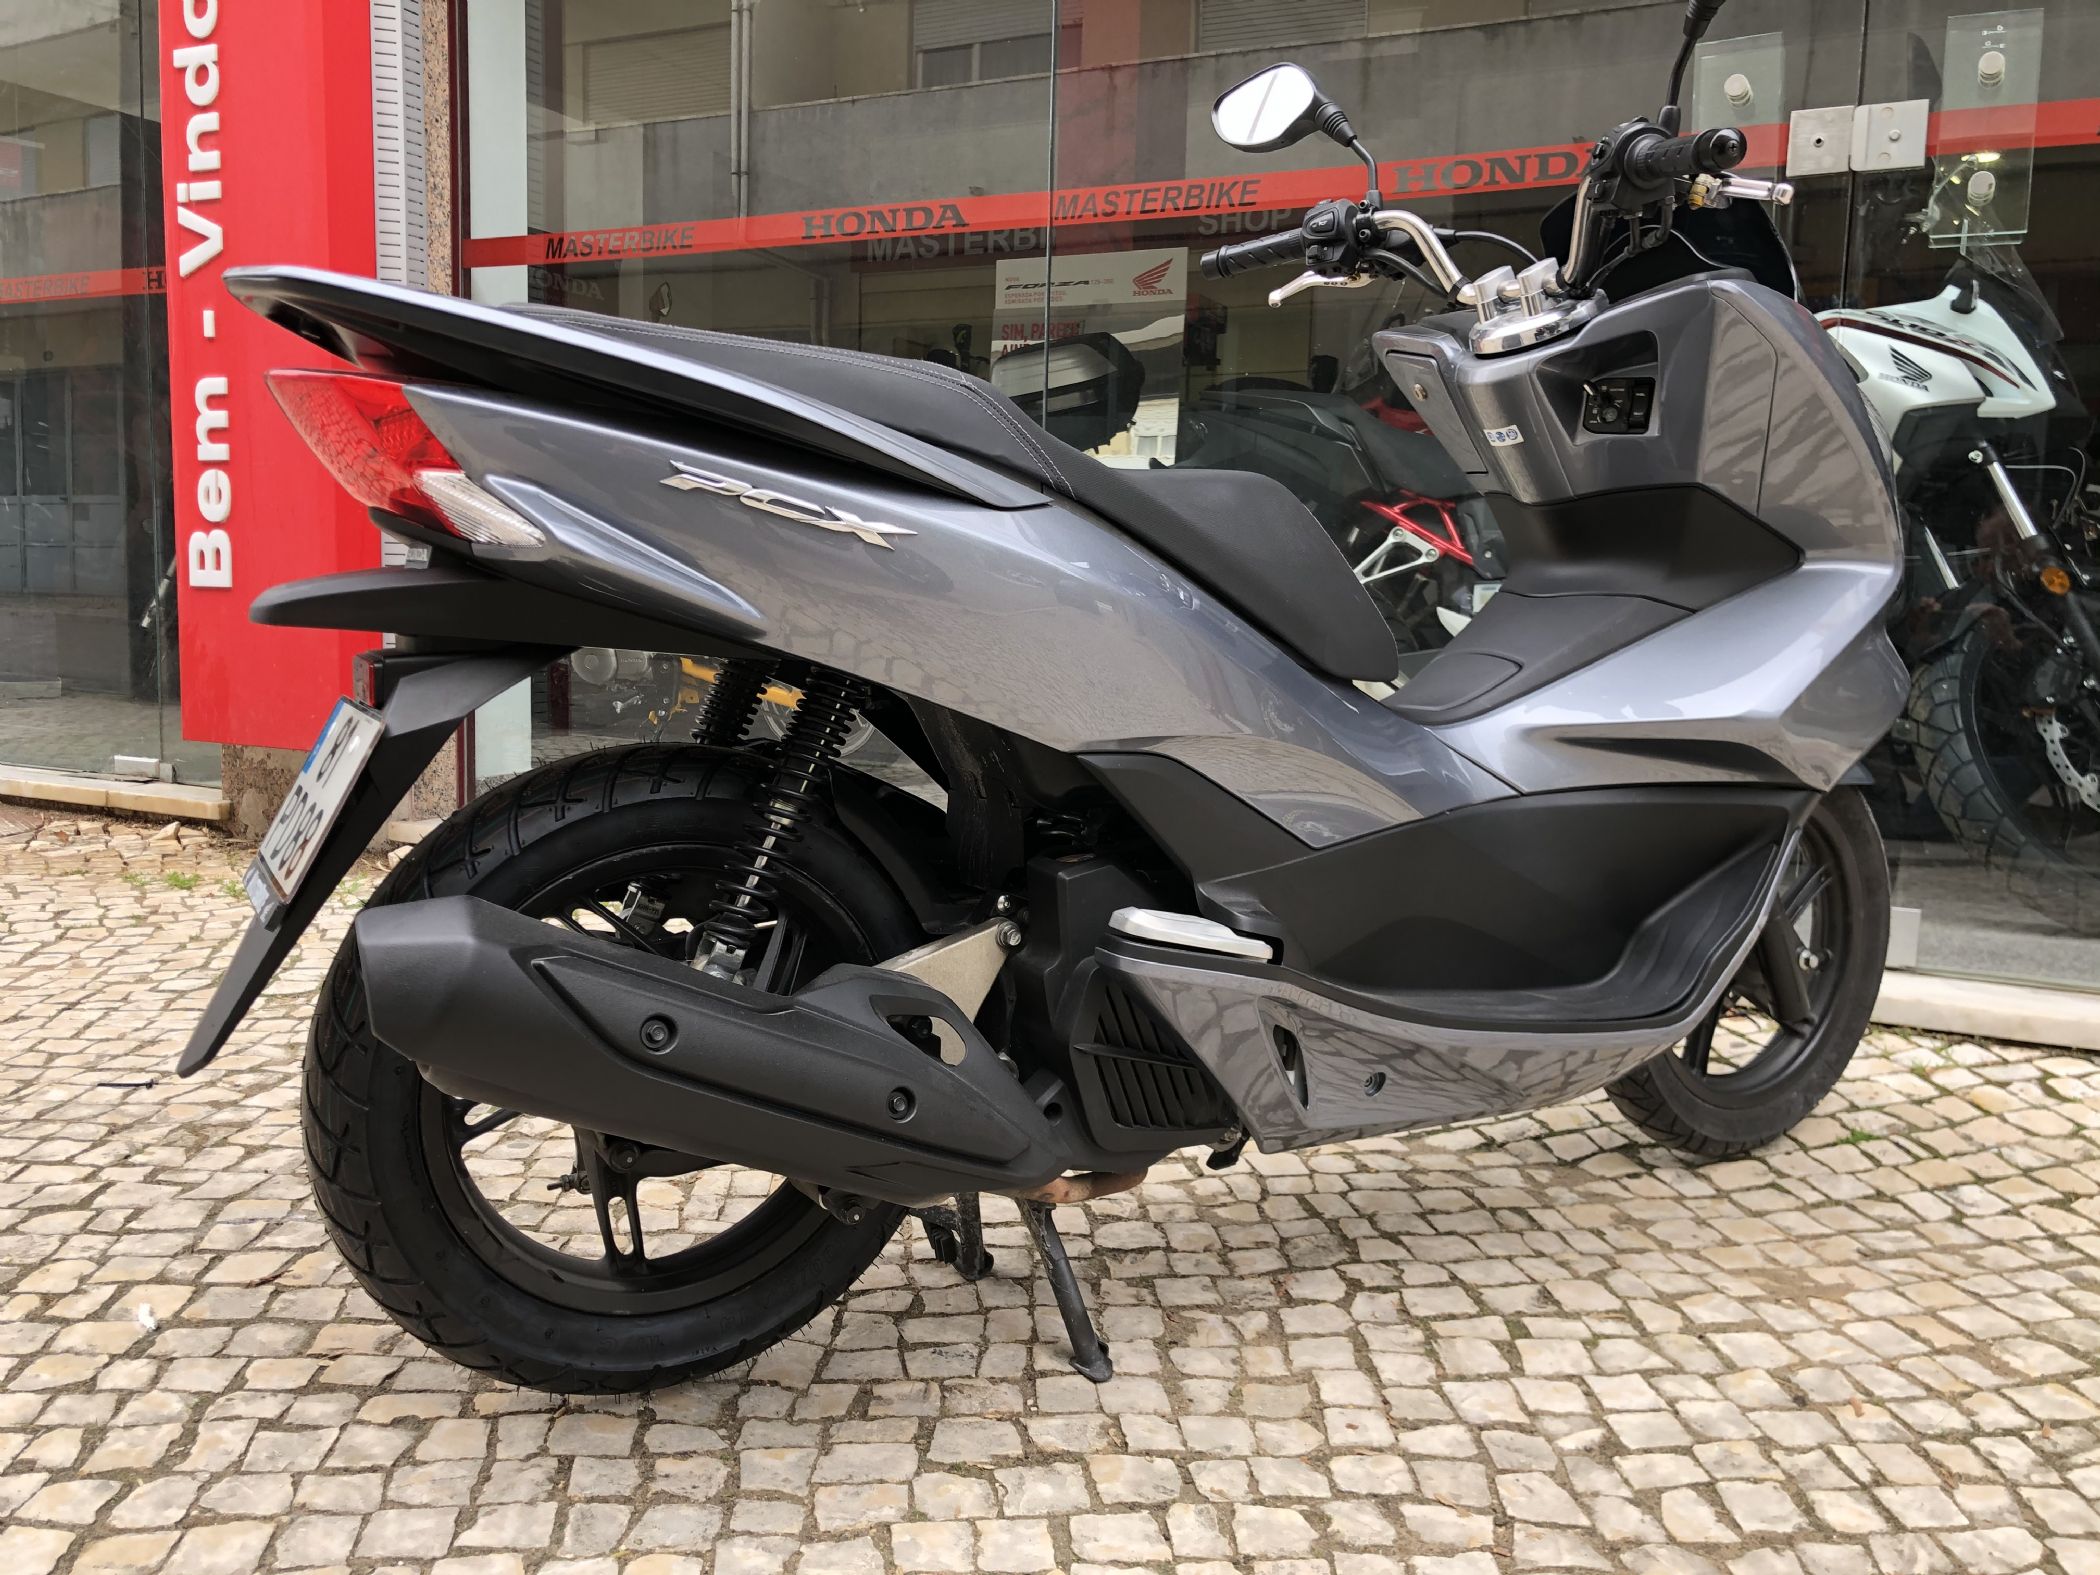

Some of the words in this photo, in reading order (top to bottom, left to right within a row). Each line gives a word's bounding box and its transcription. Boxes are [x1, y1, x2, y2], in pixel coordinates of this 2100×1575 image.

[1054, 178, 1262, 221] MASTERBIKE
[801, 203, 970, 241] HONDA
[545, 226, 696, 260] MASTERBIKE
[1132, 288, 1174, 297] HONDA
[1879, 371, 1930, 393] HONDA
[188, 376, 233, 588] Bem
[659, 458, 919, 551] PCX
